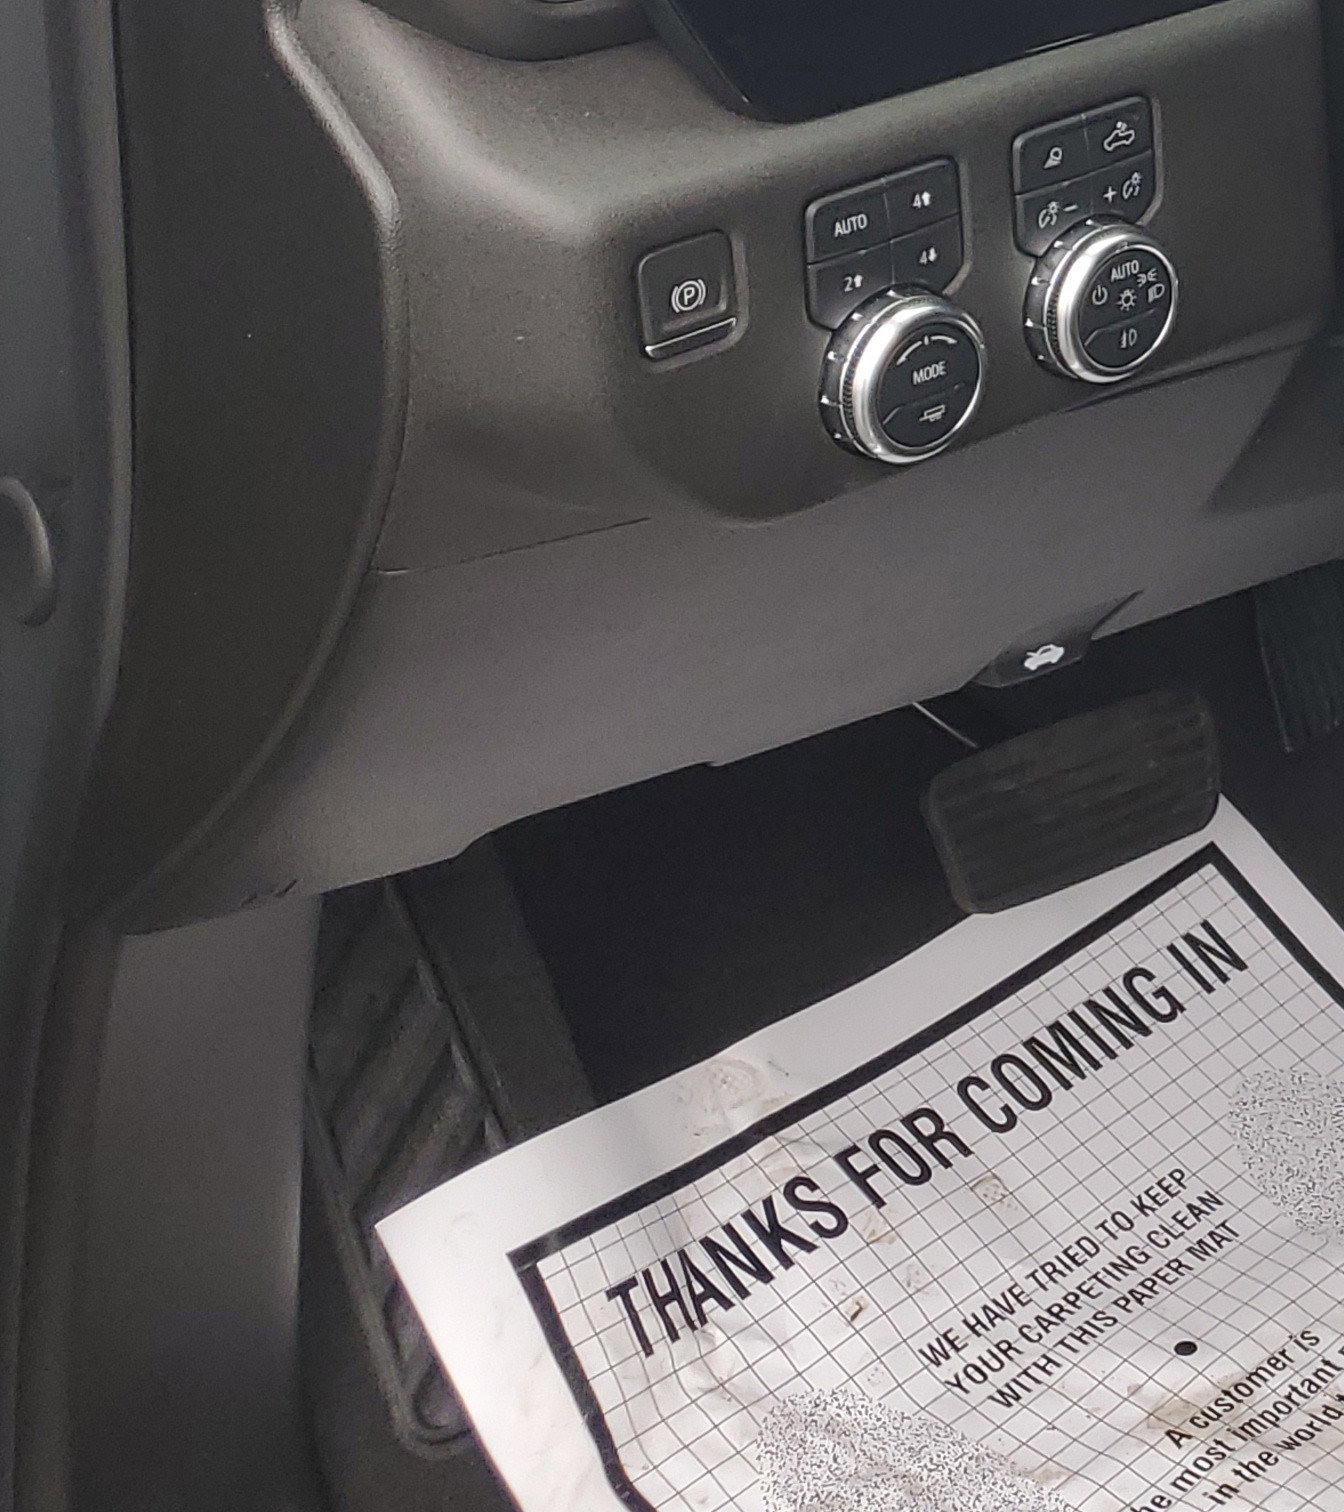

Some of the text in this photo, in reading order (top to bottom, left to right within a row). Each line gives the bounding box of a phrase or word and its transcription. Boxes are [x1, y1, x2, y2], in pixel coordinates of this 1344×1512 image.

[832, 212, 869, 238] AUTO
[1109, 258, 1141, 284] AUTO
[911, 360, 948, 387] MODE
[606, 919, 1250, 1359] THANKS FOR COMING IN
[917, 1167, 1189, 1369] WE HAVE TRIED TO KEEP
[944, 1189, 1225, 1396] YOUR CARPETING CLEAN
[986, 1219, 1241, 1409] WITH THIS PAPER MAT
[1163, 1329, 1321, 1450] A customer is
[1170, 1438, 1236, 1493] most
[1226, 1357, 1342, 1442] important
[1203, 1482, 1240, 1506] in
[1231, 1449, 1280, 1484] the
[1273, 1403, 1344, 1452] world
